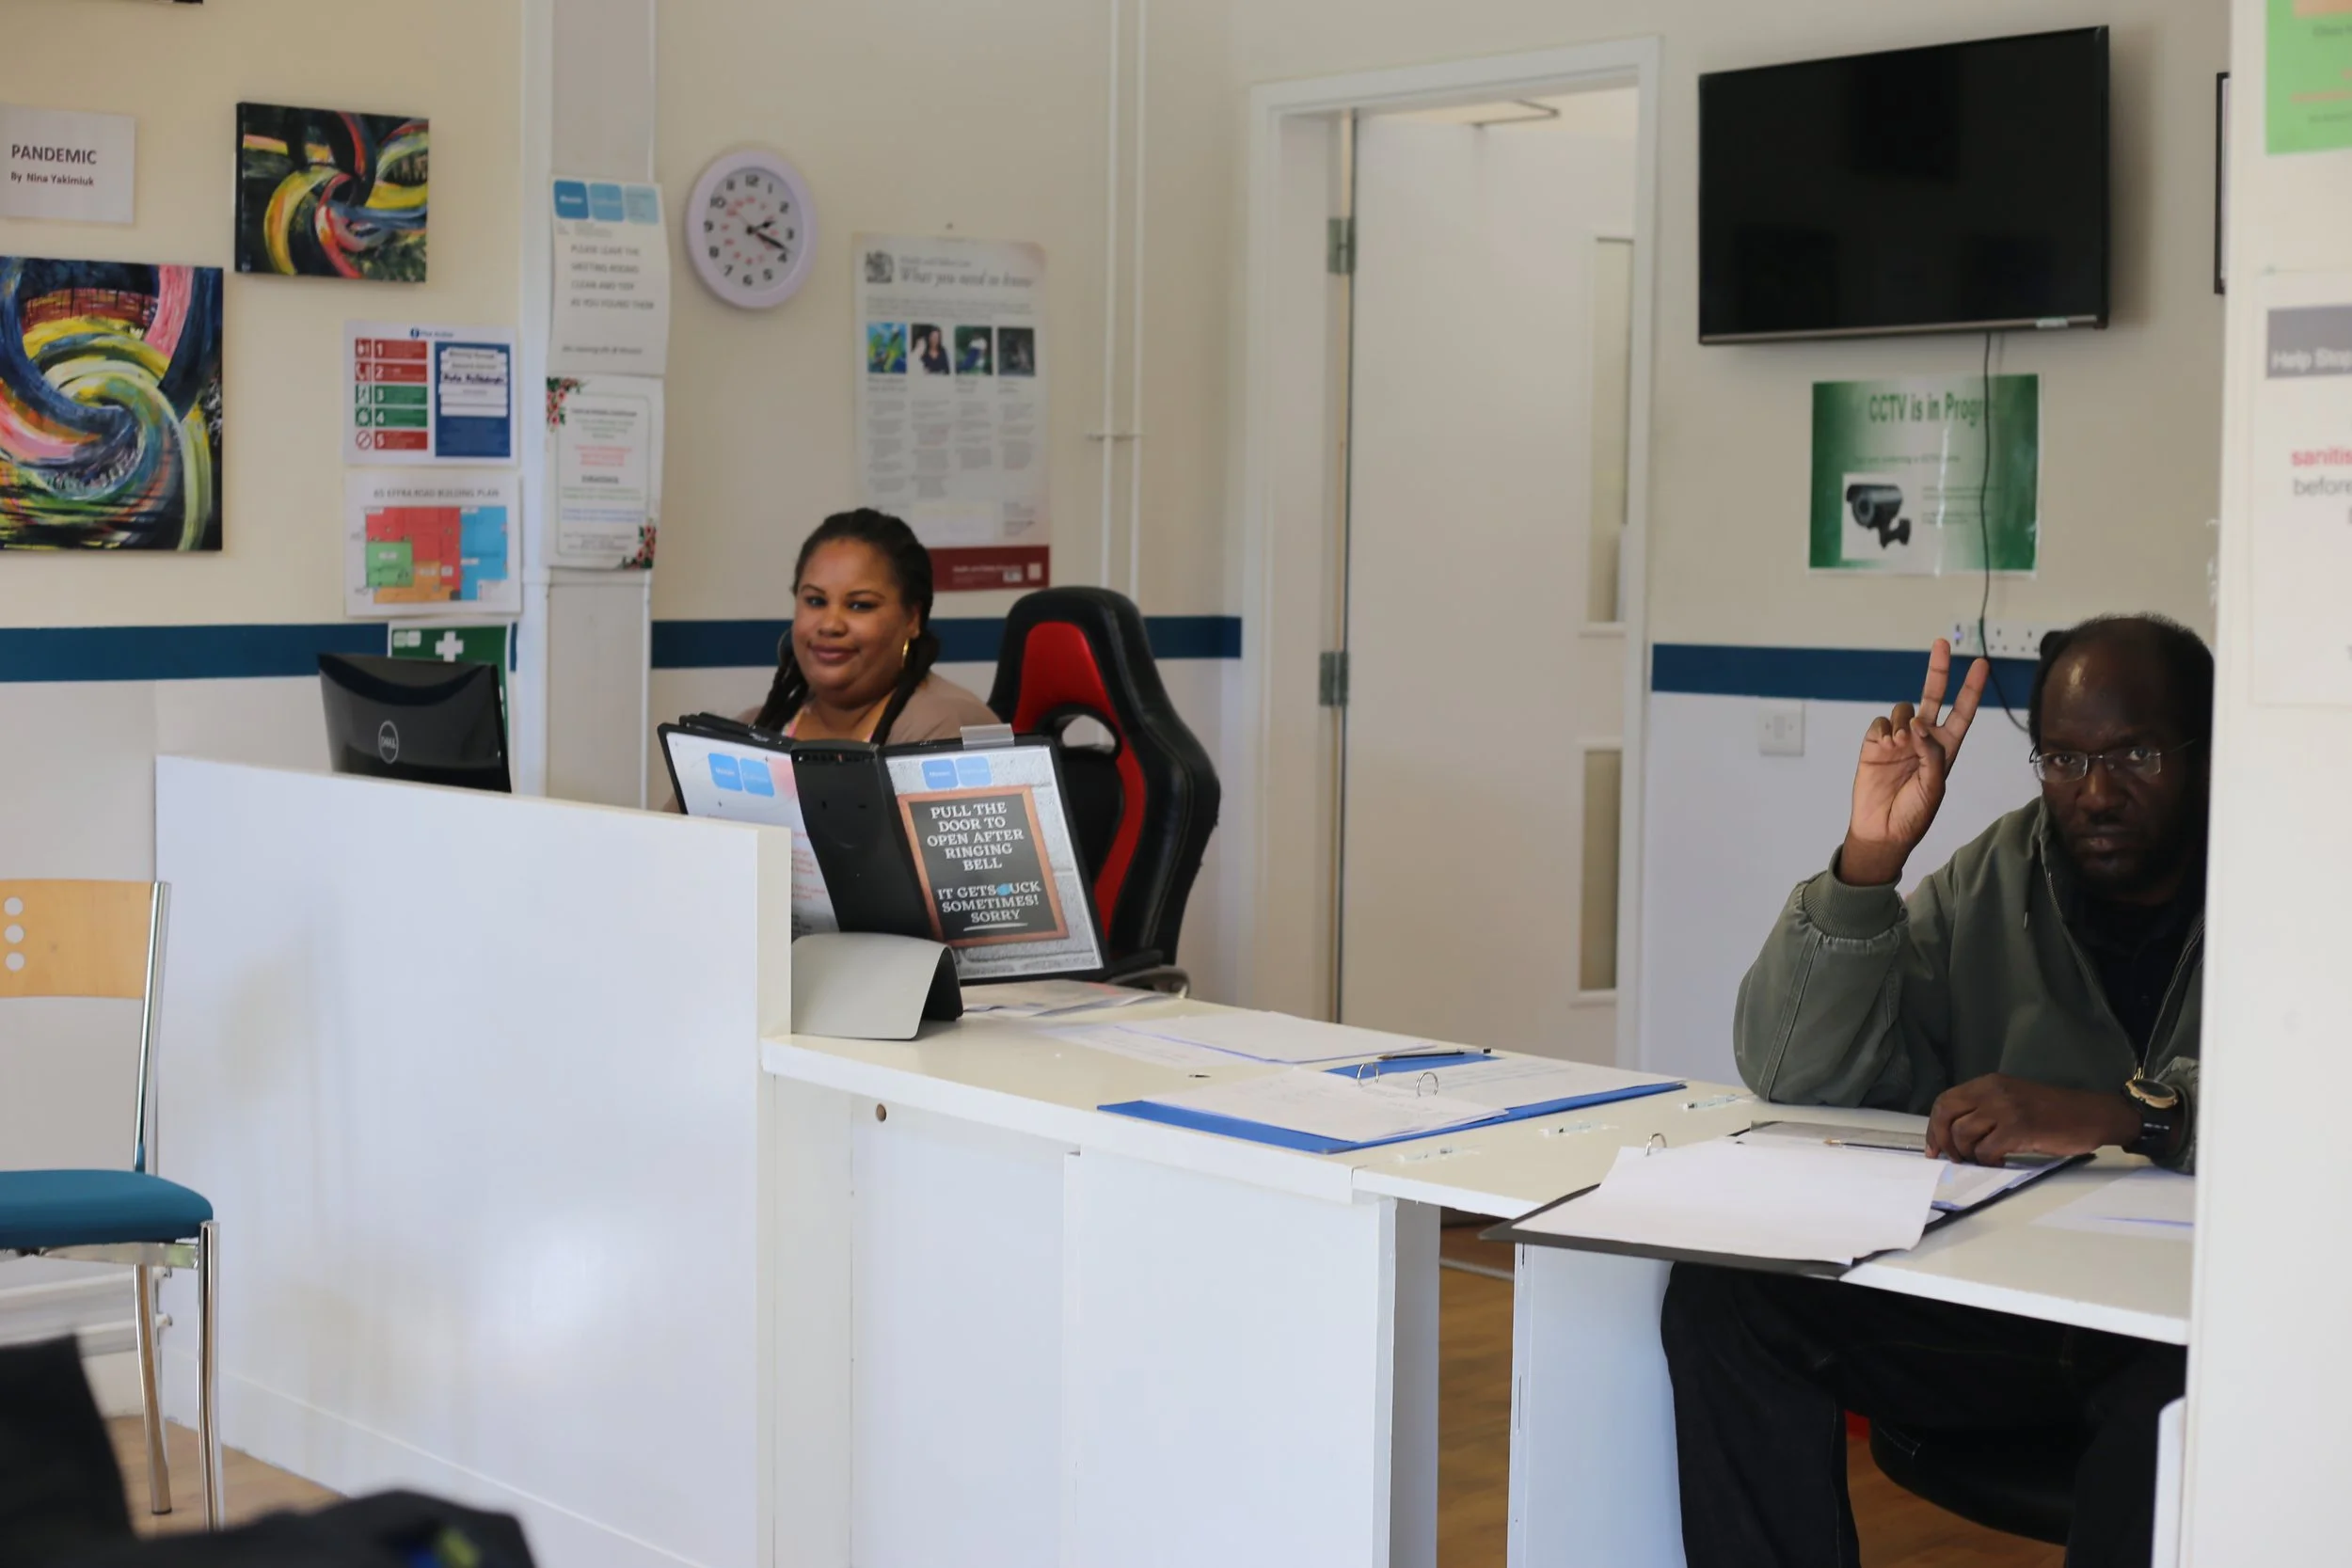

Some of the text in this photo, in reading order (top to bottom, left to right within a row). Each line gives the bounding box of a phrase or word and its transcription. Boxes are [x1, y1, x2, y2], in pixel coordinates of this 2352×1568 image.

[11, 144, 98, 165] PANDEMIC
[10, 171, 94, 186] By Nina Yakimiuk
[745, 174, 759, 187] 12
[710, 196, 725, 209] 10
[780, 201, 789, 214] 2
[704, 220, 713, 232] 9
[787, 228, 794, 241] 3
[708, 245, 720, 259] 8
[723, 264, 734, 277] 7
[763, 268, 773, 281] 5
[899, 267, 931, 282] What
[934, 271, 955, 287] you
[959, 268, 986, 286] need
[742, 275, 753, 286] 6
[376, 343, 383, 356] 1
[2271, 350, 2312, 372] Help
[376, 367, 384, 379] 2
[377, 388, 384, 402] 3
[1869, 395, 1907, 422] CCTV
[1911, 393, 1923, 420] is
[1927, 392, 1940, 420] in
[376, 411, 385, 423] 4
[377, 434, 385, 445] 5
[930, 801, 1007, 819] PULL THE
[938, 816, 1006, 832] DOOR TO
[927, 828, 1025, 847] OPEN AFTER
[945, 843, 1013, 859] RINGING
[962, 857, 1002, 871] BELL
[936, 880, 1041, 900] IT GETS UCK
[942, 895, 1039, 912] SOMETIMES!
[971, 909, 1021, 924] SORRY
